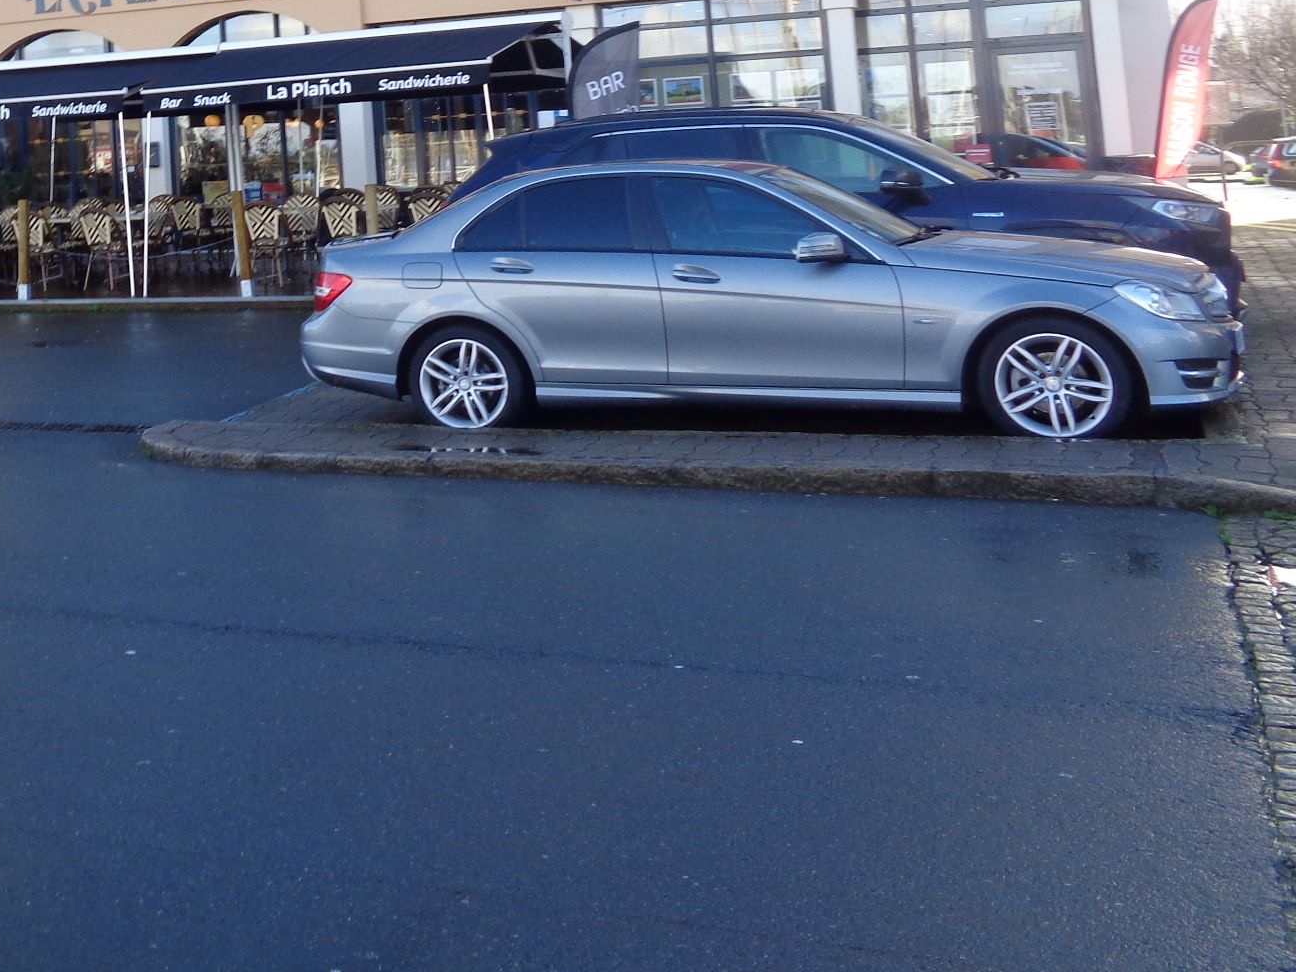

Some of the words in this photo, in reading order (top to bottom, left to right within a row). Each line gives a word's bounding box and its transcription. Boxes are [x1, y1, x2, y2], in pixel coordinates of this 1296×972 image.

[160, 95, 182, 110] Bar
[193, 91, 232, 107] Snack
[266, 84, 288, 101] La
[291, 77, 352, 99] Plañch
[377, 71, 471, 92] Sandwicherie
[585, 71, 626, 101] BAR
[1174, 43, 1202, 100] ROUGE
[31, 100, 108, 118] Sandwicherie
[1164, 101, 1196, 166] MAISON
